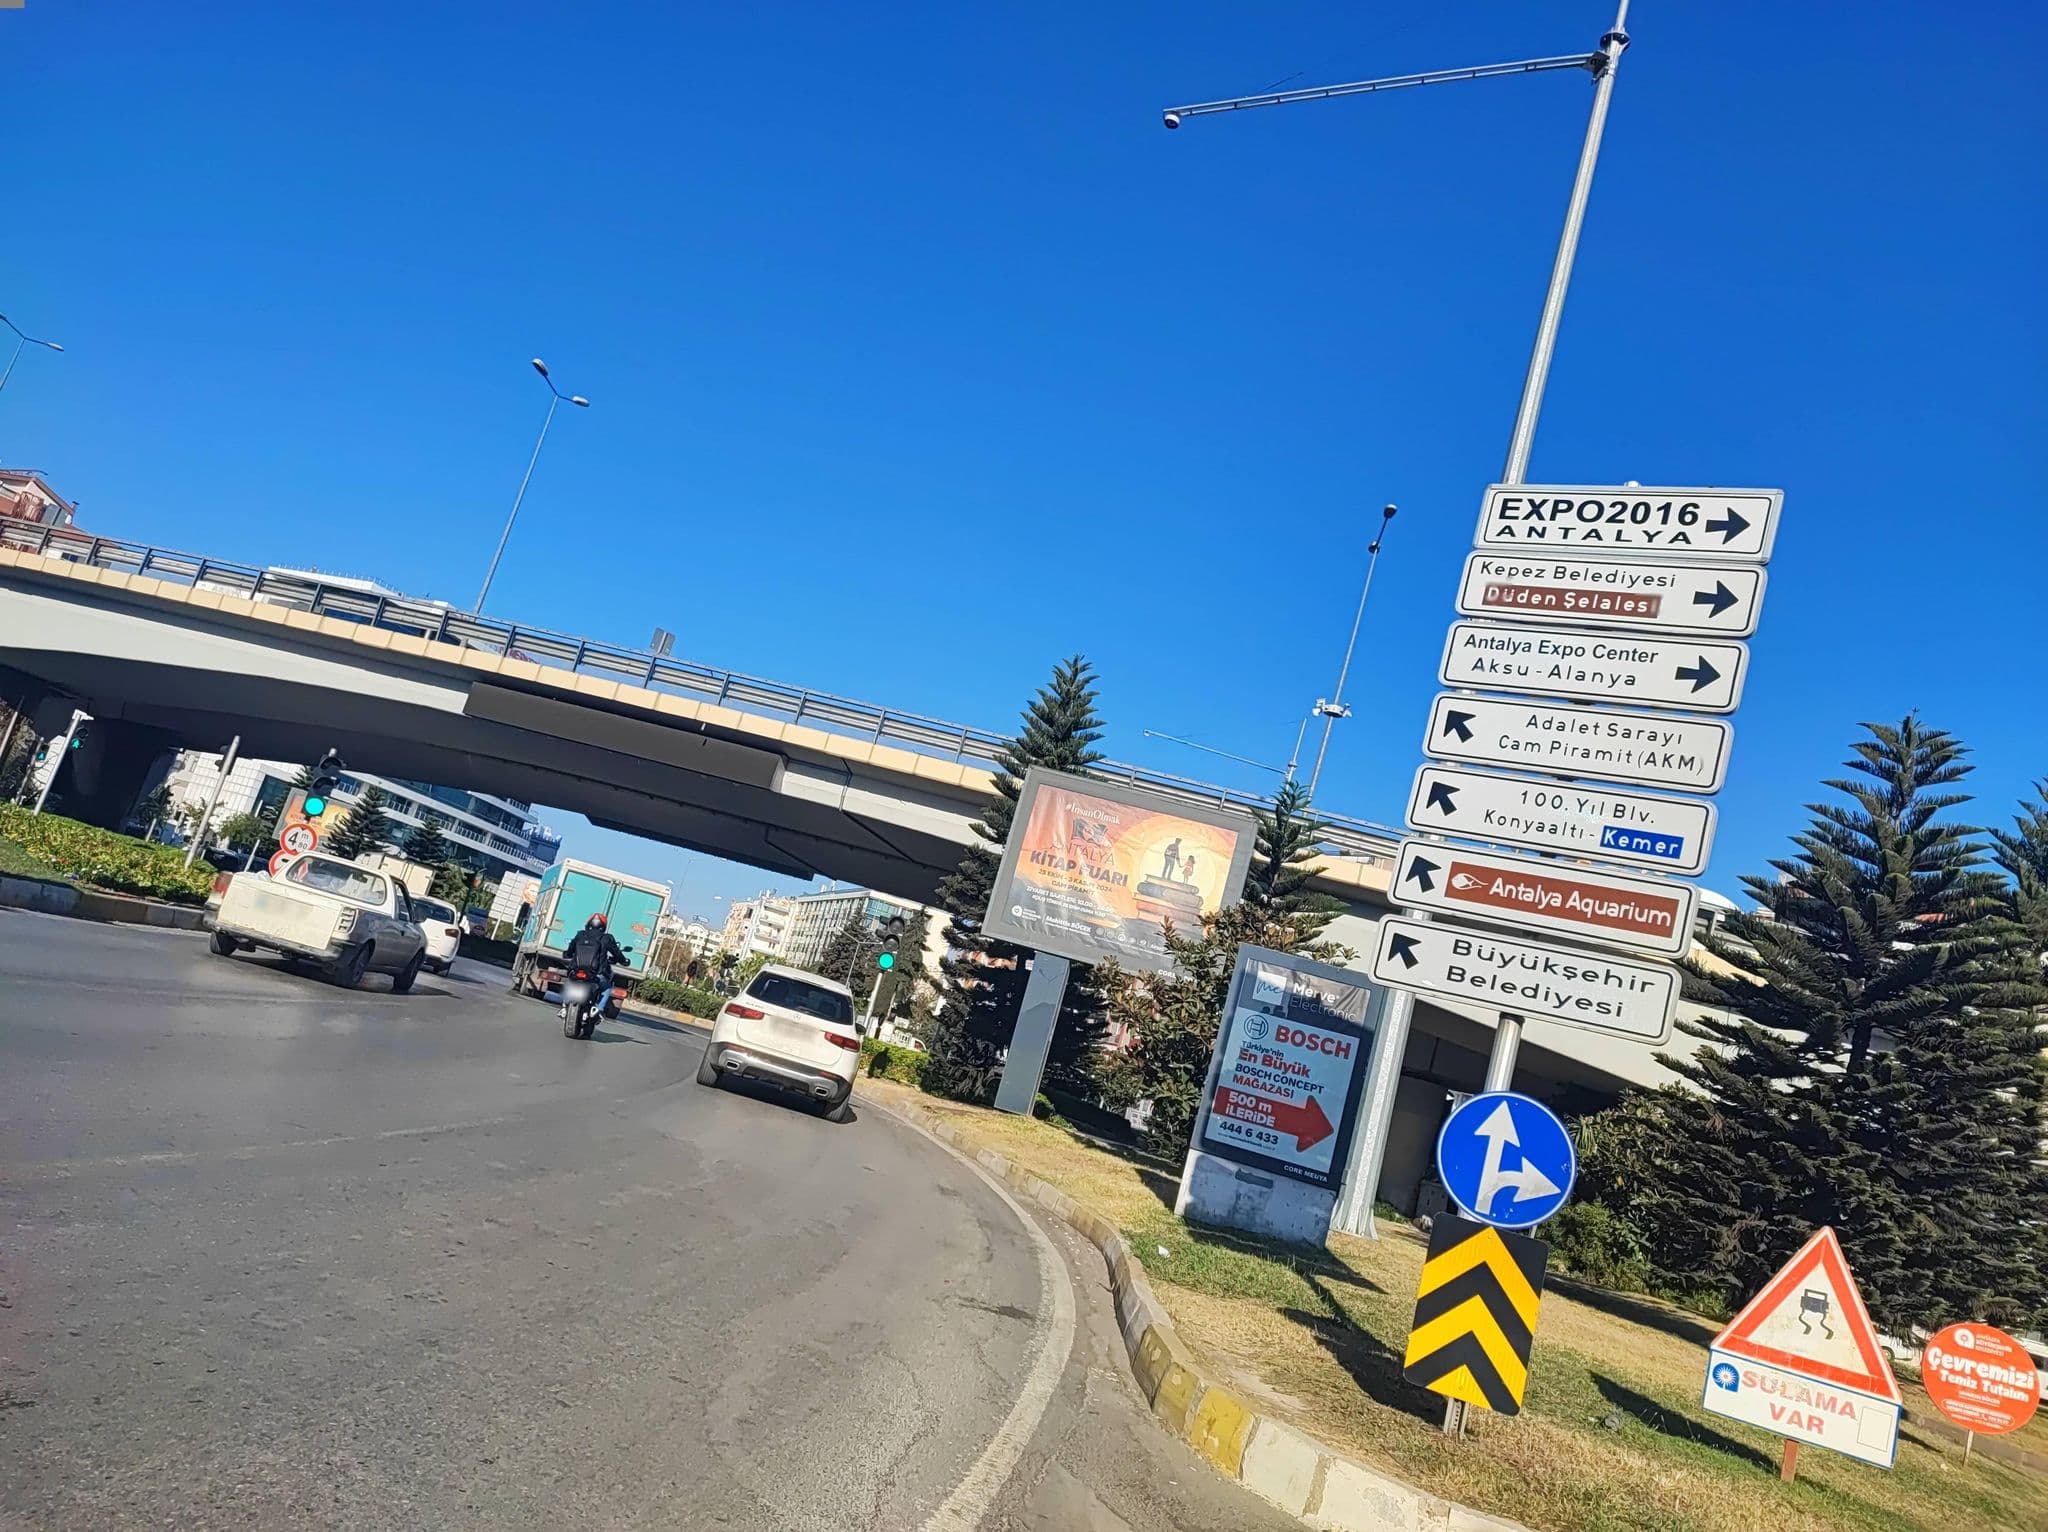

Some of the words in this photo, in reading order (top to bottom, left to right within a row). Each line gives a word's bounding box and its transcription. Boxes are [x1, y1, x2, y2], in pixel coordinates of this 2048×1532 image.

[1498, 497, 1701, 527] EXPO2016
[1496, 524, 1692, 545] ANTALYA
[1480, 561, 1546, 580] Kepez
[1553, 565, 1676, 588] Belediyesi
[1487, 586, 1556, 606] Düden
[1464, 633, 1532, 655] Antalya
[1537, 636, 1586, 660] Expo
[1592, 644, 1659, 664] Center
[1525, 714, 1600, 737] Adalet
[1607, 723, 1682, 747] Sarayı
[1498, 735, 1541, 754] Cam
[1549, 741, 1633, 764] Piramit
[1636, 751, 1703, 776] (AKM)
[1520, 790, 1568, 812] 100.
[1576, 799, 1603, 817] Yıl
[1613, 802, 1655, 824] Blv.
[287, 831, 299, 845] 4
[1049, 839, 1114, 866] ANTALYA
[1602, 829, 1679, 856] Kemer
[1030, 850, 1077, 872] KİTAP
[1078, 862, 1128, 887] FUARI
[1489, 877, 1562, 908] Antalya
[1565, 890, 1672, 928] Aquarium
[1452, 939, 1655, 994] Büyükşehir
[1293, 983, 1336, 1003] Merve
[1446, 966, 1624, 1018] Belediyesi
[1289, 995, 1357, 1023] Electronic
[1242, 1040, 1285, 1058] Türkiye'nin
[1275, 1024, 1352, 1060] BOSCH
[1235, 1063, 1273, 1081] BOSCH
[1273, 1074, 1325, 1094] CONCEPT
[1238, 1048, 1258, 1063] En
[1261, 1053, 1312, 1079] Büyük
[1228, 1091, 1256, 1107] 500
[1258, 1102, 1272, 1113] m
[1232, 1074, 1294, 1099] MAĞAZASI
[1220, 1121, 1242, 1135] 444
[1245, 1127, 1253, 1138] 6
[1255, 1130, 1279, 1145] 433
[1283, 1164, 1303, 1175] CORE
[1927, 1346, 2035, 1390] Çevremizi
[1741, 1369, 1857, 1422] SULAMA
[1939, 1369, 1978, 1390] Temiz
[1981, 1379, 2030, 1403] Tutalım
[1769, 1403, 1825, 1436] VAR
